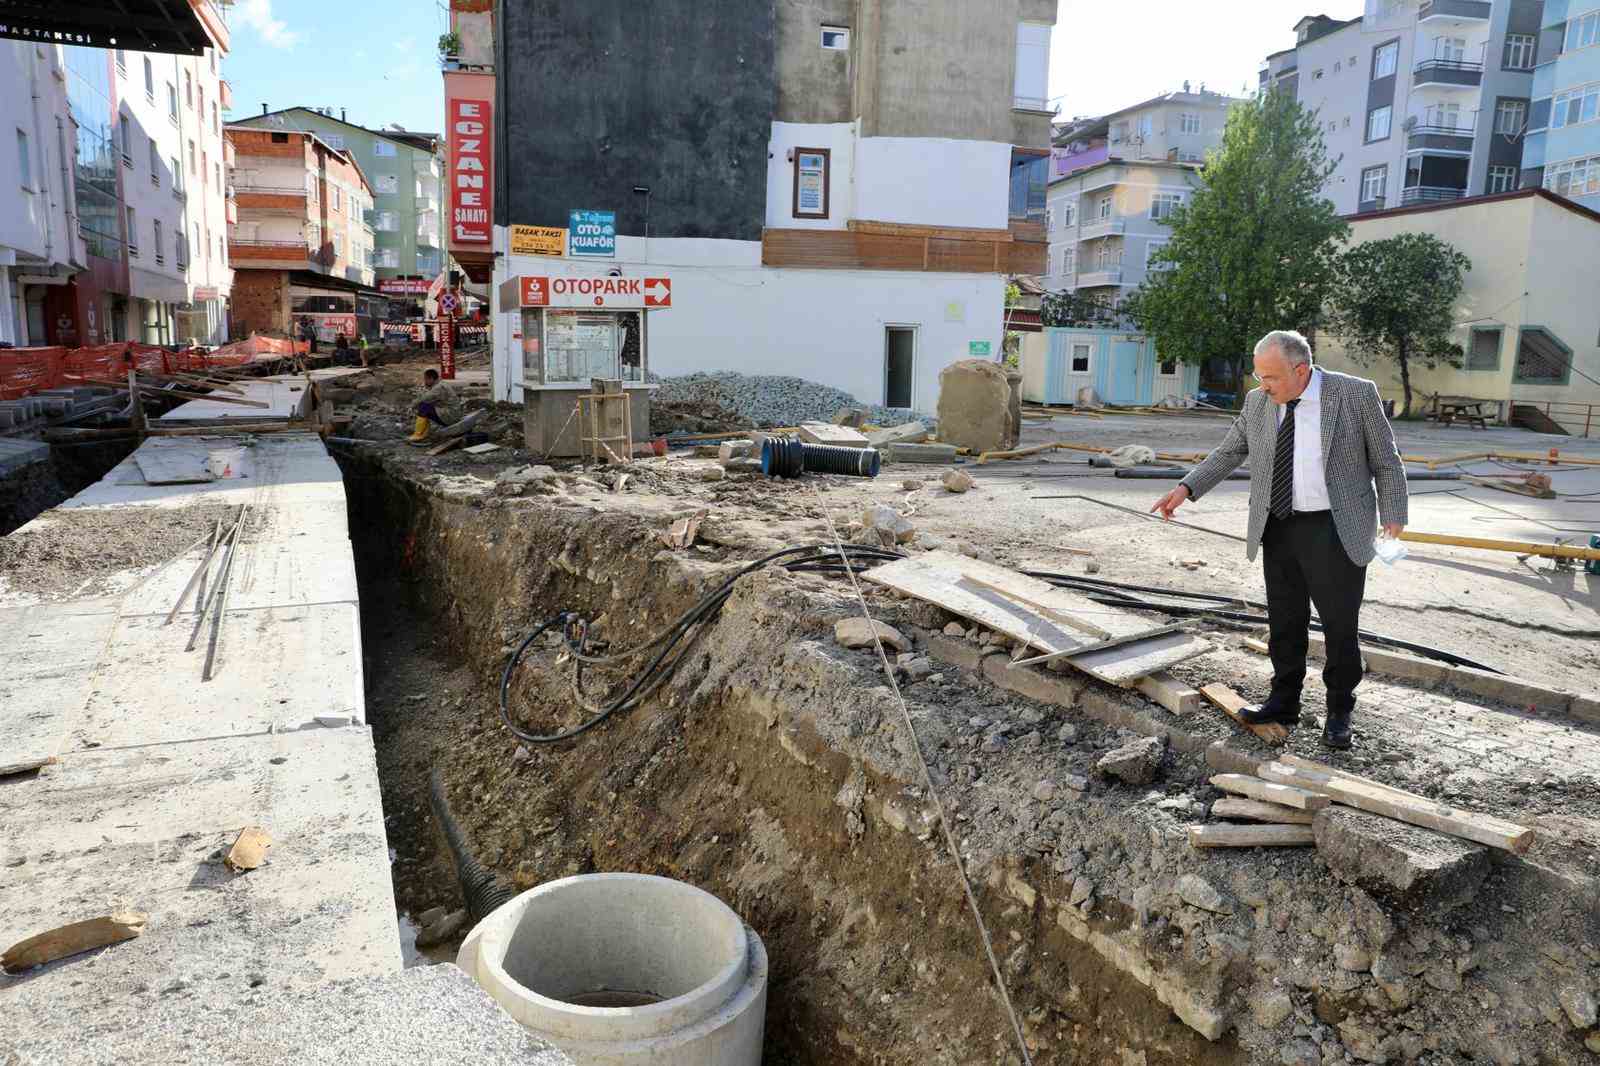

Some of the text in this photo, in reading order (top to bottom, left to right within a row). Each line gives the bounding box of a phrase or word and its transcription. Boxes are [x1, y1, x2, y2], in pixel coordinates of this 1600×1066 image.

[456, 103, 484, 206] ECZANE
[577, 224, 600, 234] OTO
[571, 235, 614, 248] KUAFÖR
[553, 278, 640, 295] OTOPARK
